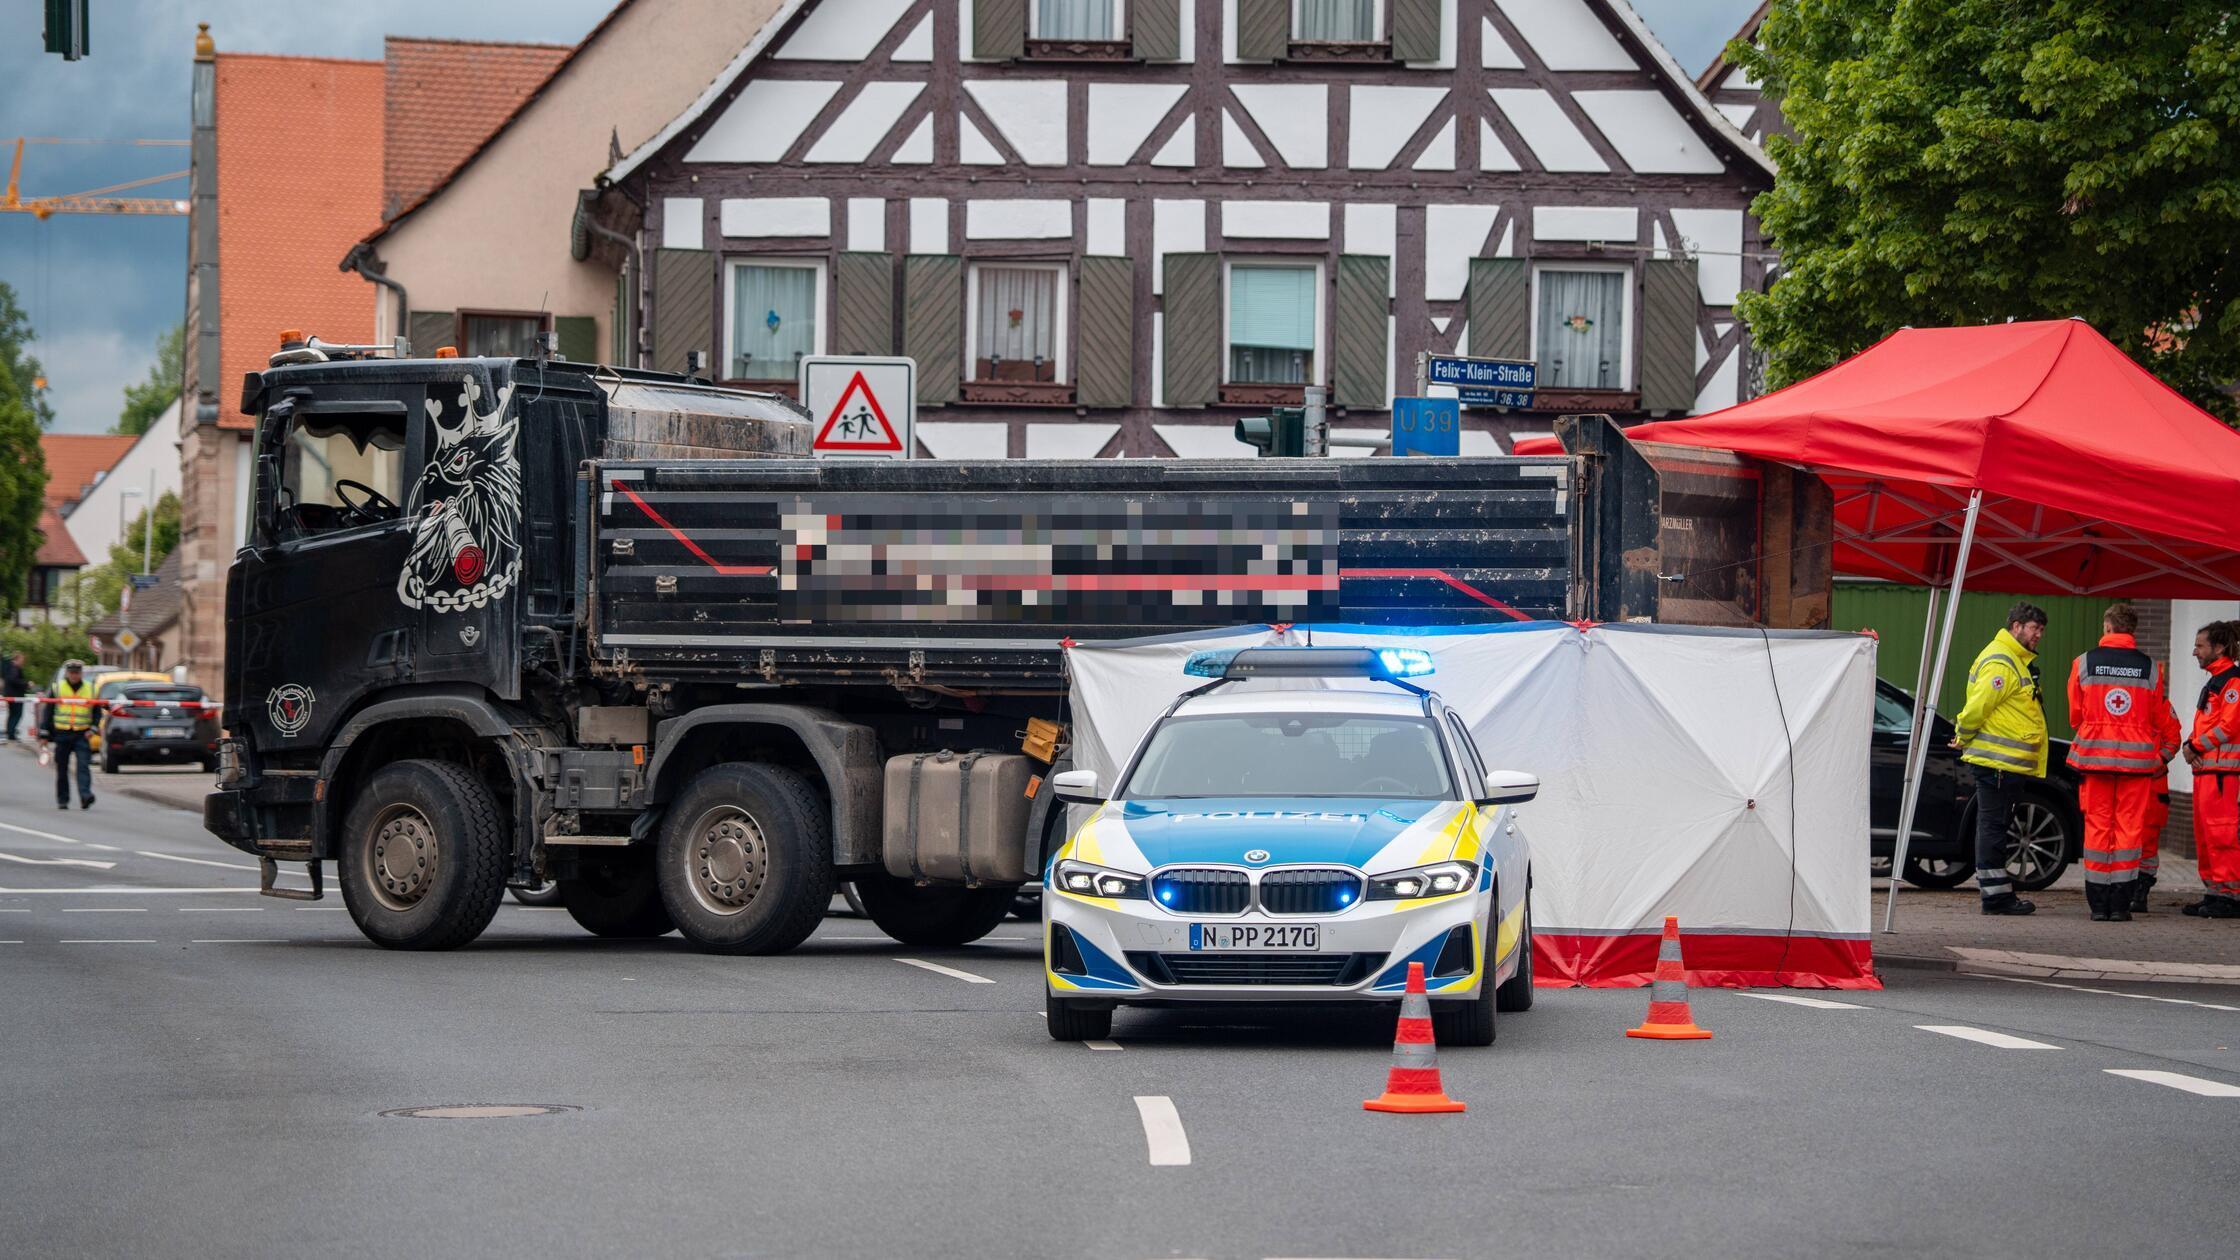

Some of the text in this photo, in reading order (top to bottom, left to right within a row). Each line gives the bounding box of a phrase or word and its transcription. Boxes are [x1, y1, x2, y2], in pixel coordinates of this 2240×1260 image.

[1435, 361, 1532, 383] Felix-Klein-Straße
[1400, 408, 1451, 432] U 39
[2095, 665, 2143, 677] RETTUNGSDIENST
[1174, 811, 1361, 823] POLIZEI
[1203, 927, 1216, 947] N
[1231, 927, 1259, 947] PP
[1263, 927, 1316, 947] 2170
